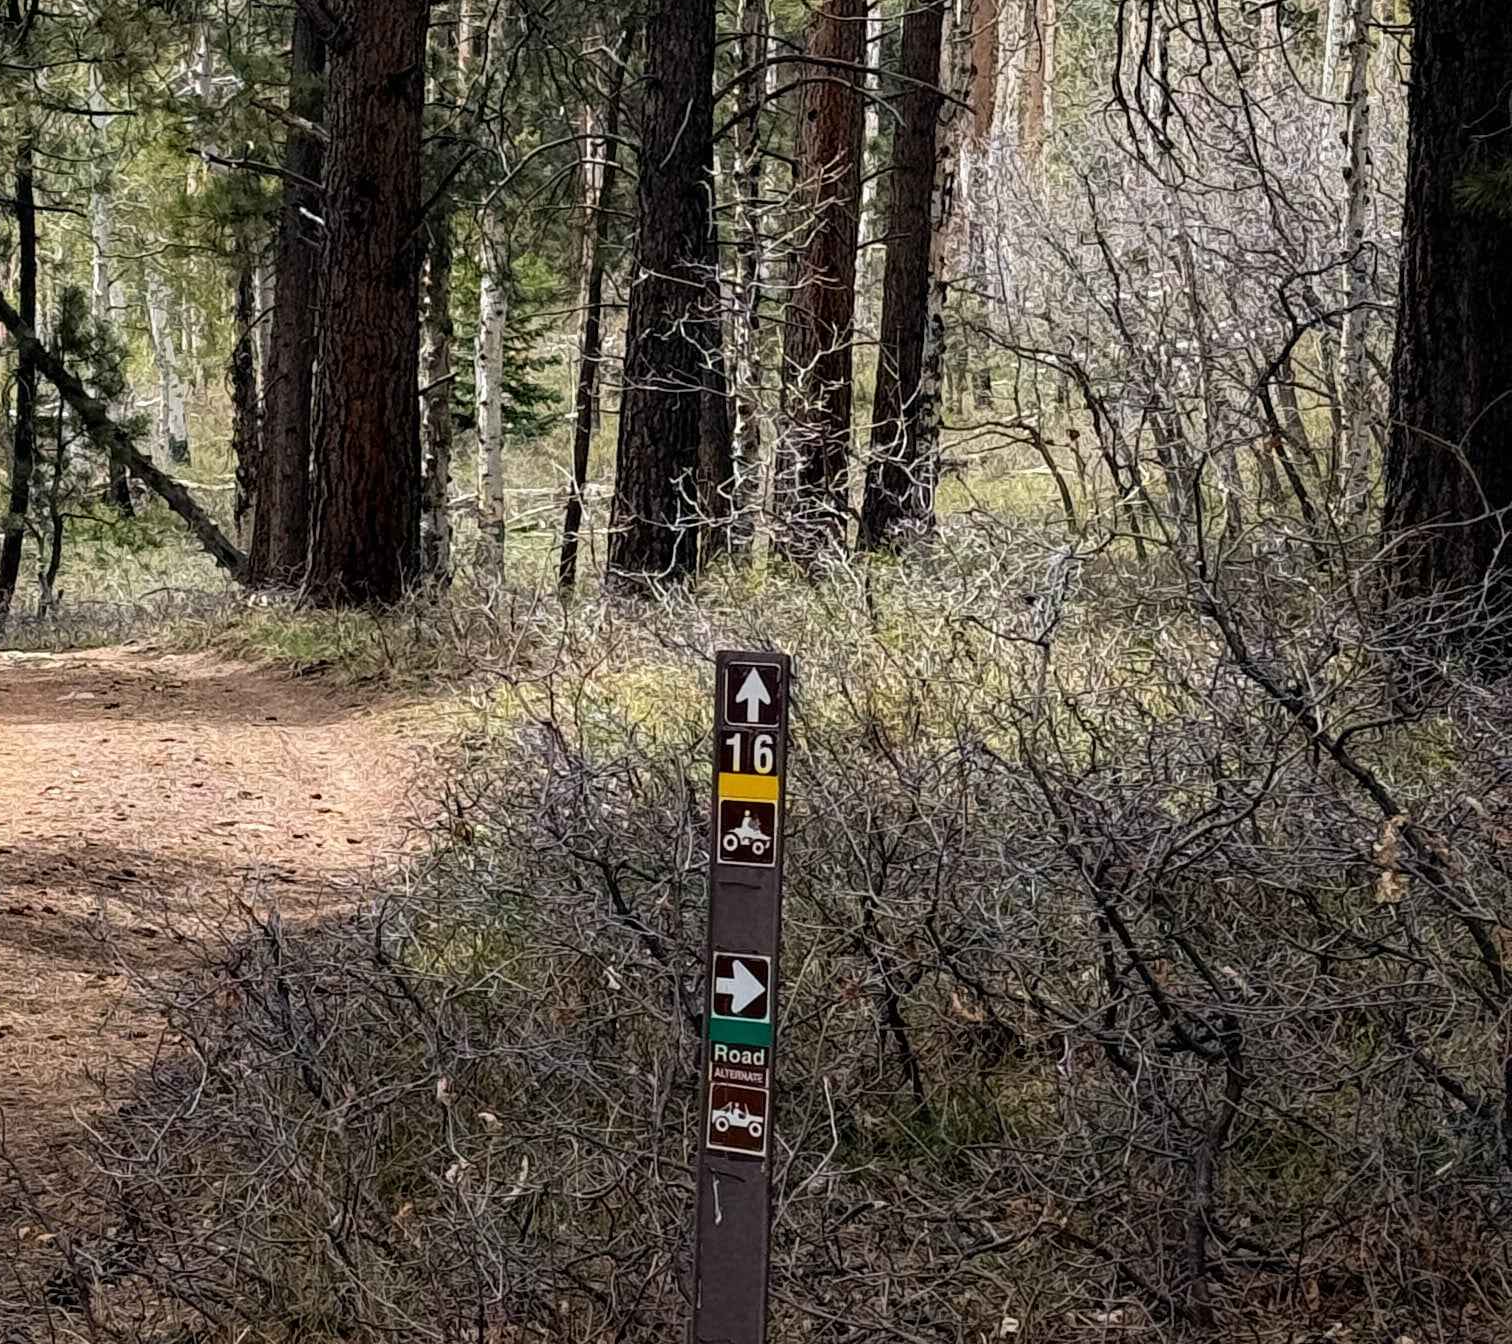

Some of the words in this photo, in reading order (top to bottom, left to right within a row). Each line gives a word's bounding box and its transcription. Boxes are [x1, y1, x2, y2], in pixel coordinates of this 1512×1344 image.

[725, 732, 774, 775] 16
[713, 1043, 766, 1066] Road
[713, 1067, 764, 1084] ALTERNATE
